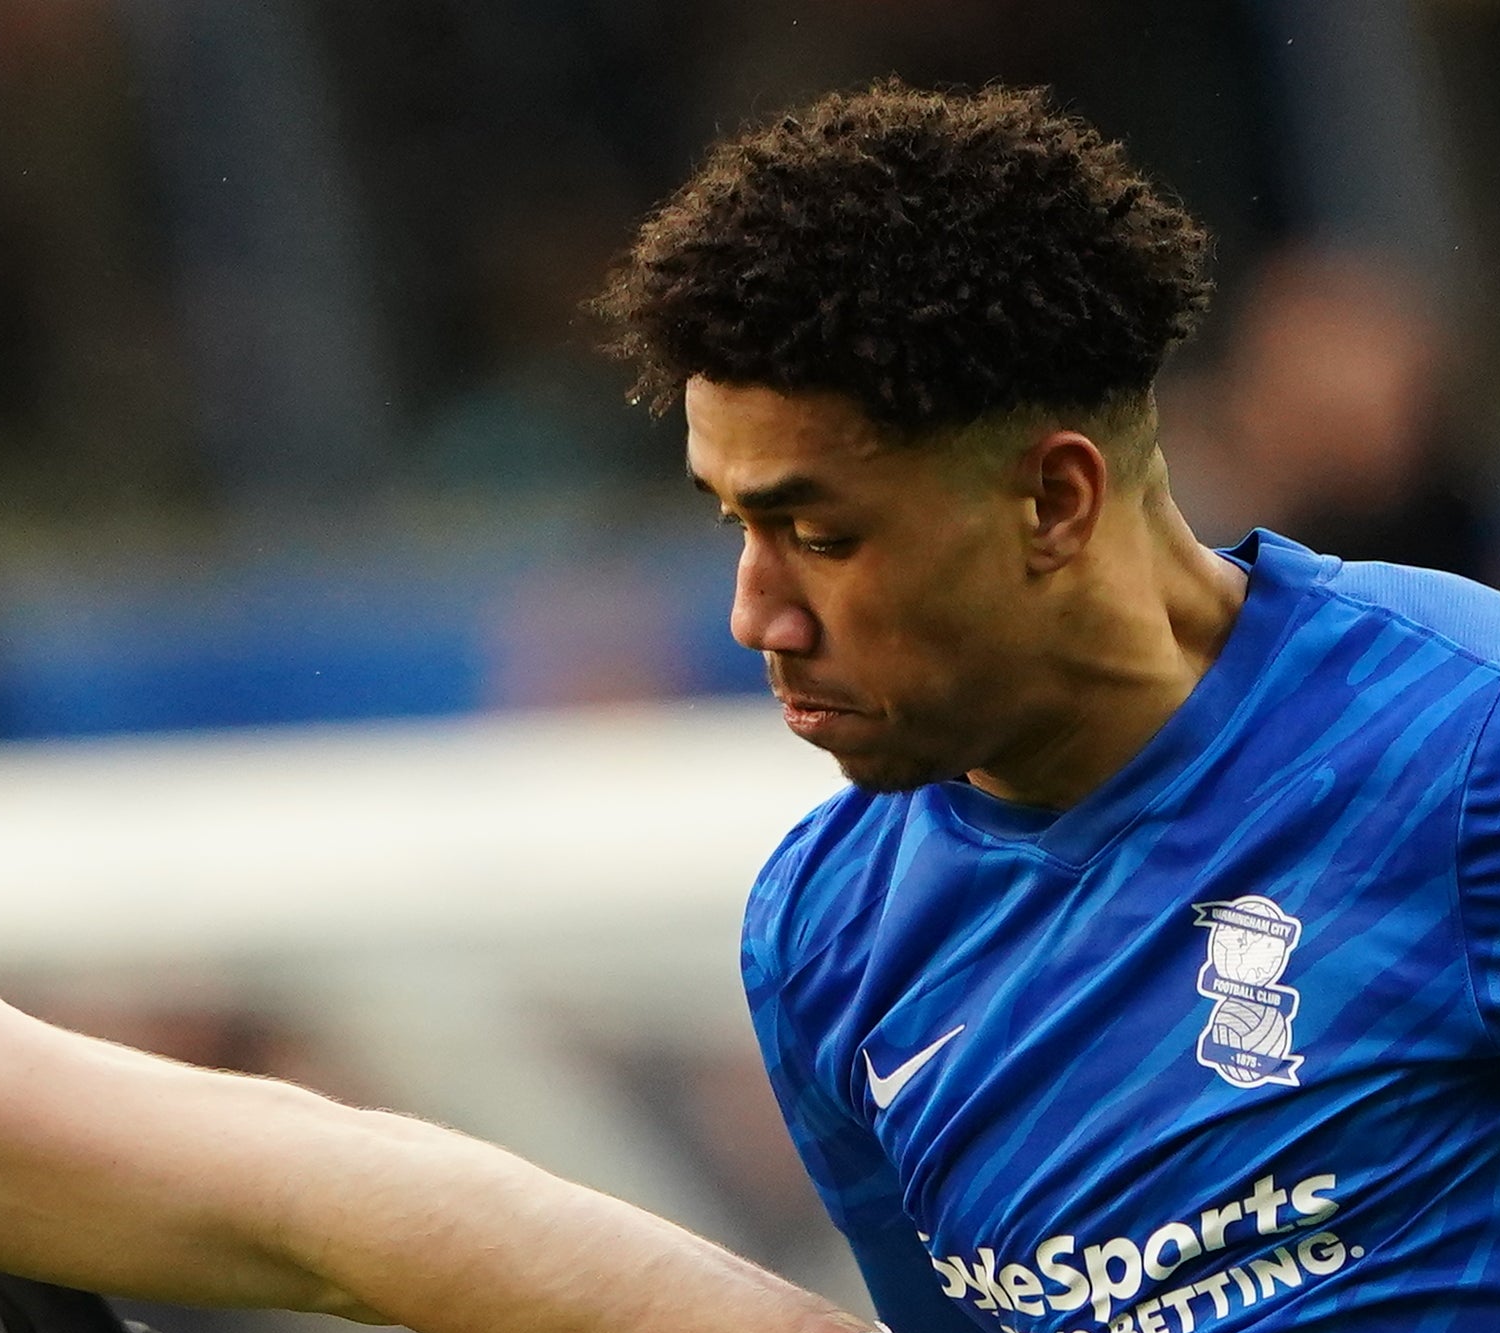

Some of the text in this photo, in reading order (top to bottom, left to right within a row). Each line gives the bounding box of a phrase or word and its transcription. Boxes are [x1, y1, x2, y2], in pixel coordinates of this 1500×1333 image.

[1270, 922, 1292, 938] CITY
[1212, 978, 1281, 1006] FOOTBALL CLUB
